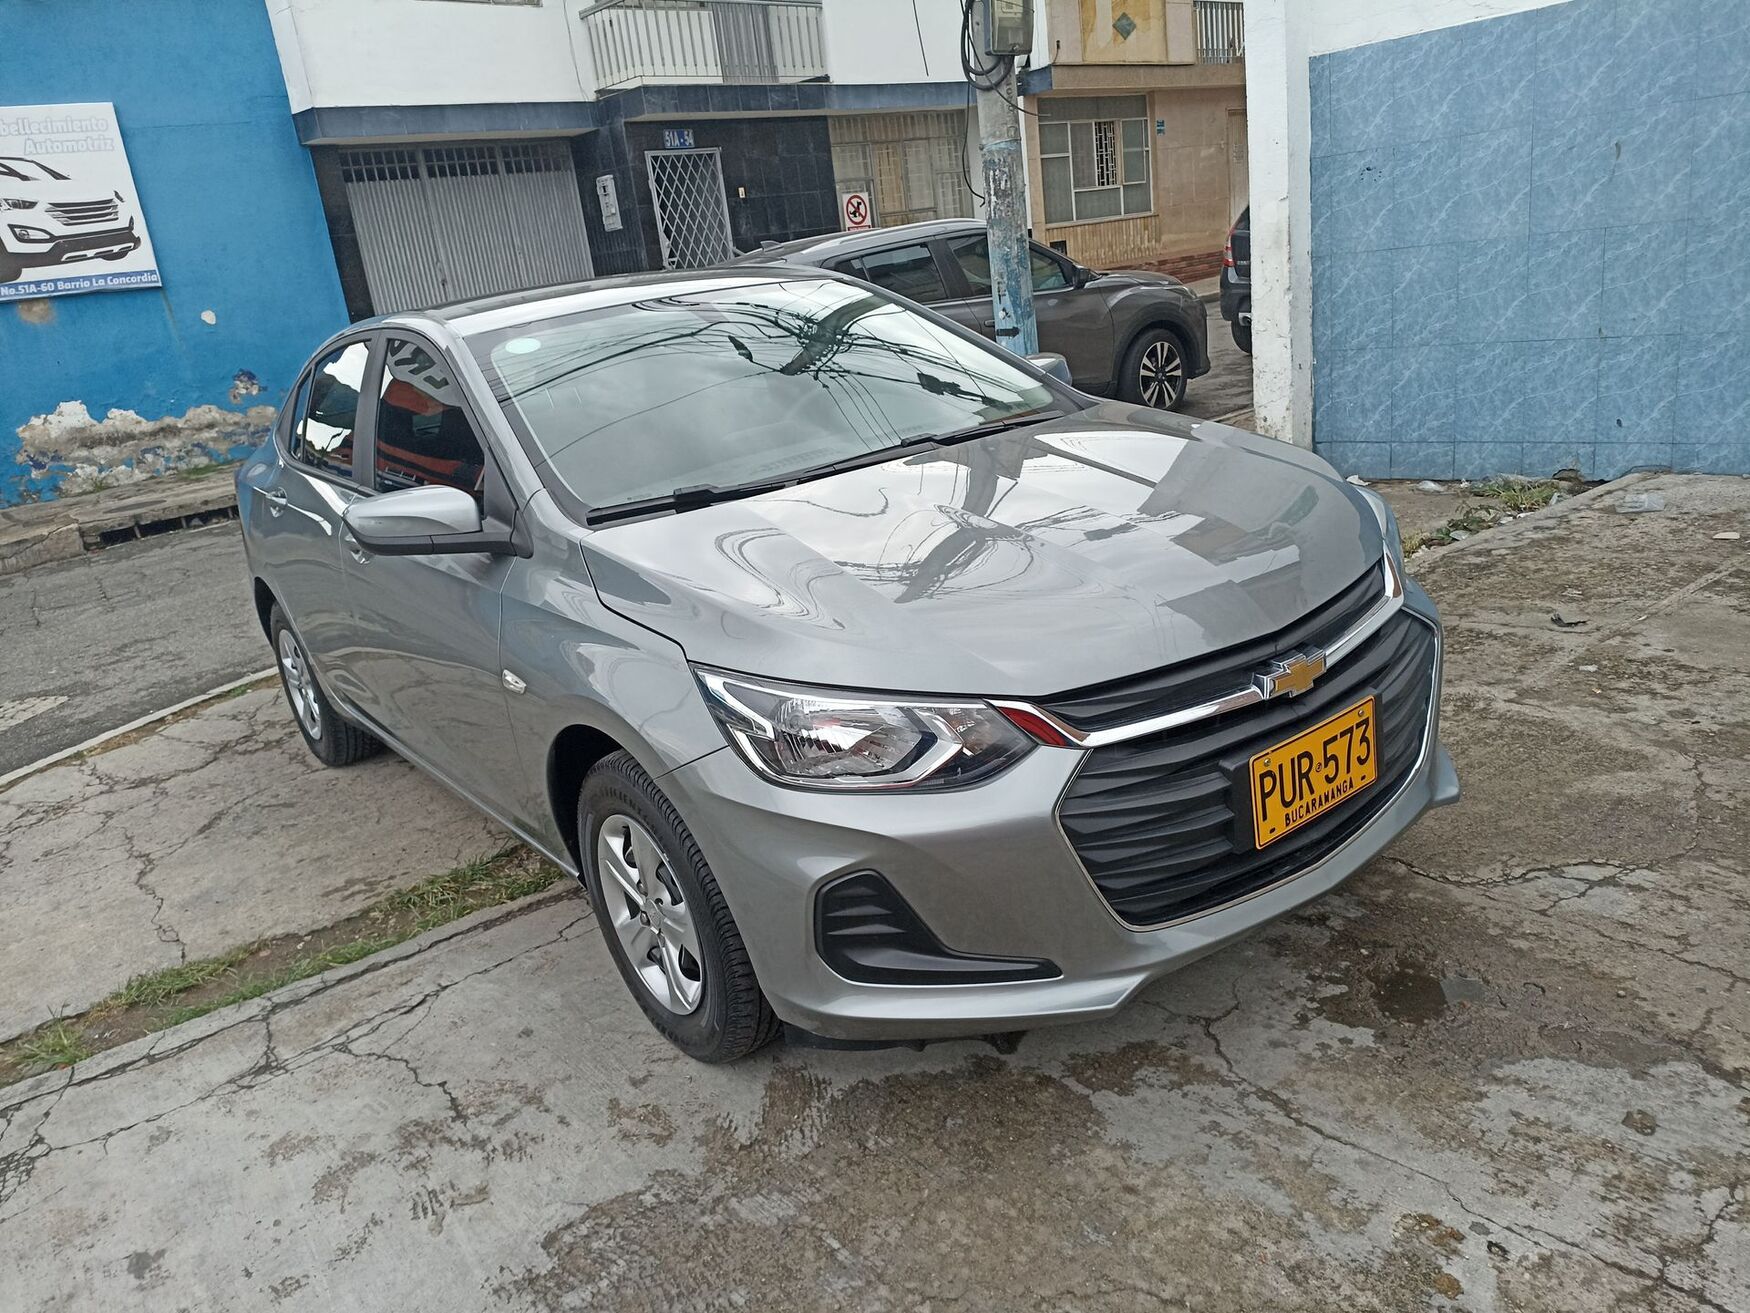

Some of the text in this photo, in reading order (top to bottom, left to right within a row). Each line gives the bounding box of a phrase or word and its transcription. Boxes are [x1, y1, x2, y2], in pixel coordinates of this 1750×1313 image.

[25, 135, 114, 154] Automotriz
[57, 279, 90, 291] Barrio
[92, 277, 106, 287] La
[107, 272, 158, 285] Concordia
[1284, 777, 1354, 827] BUCARAMANGA
